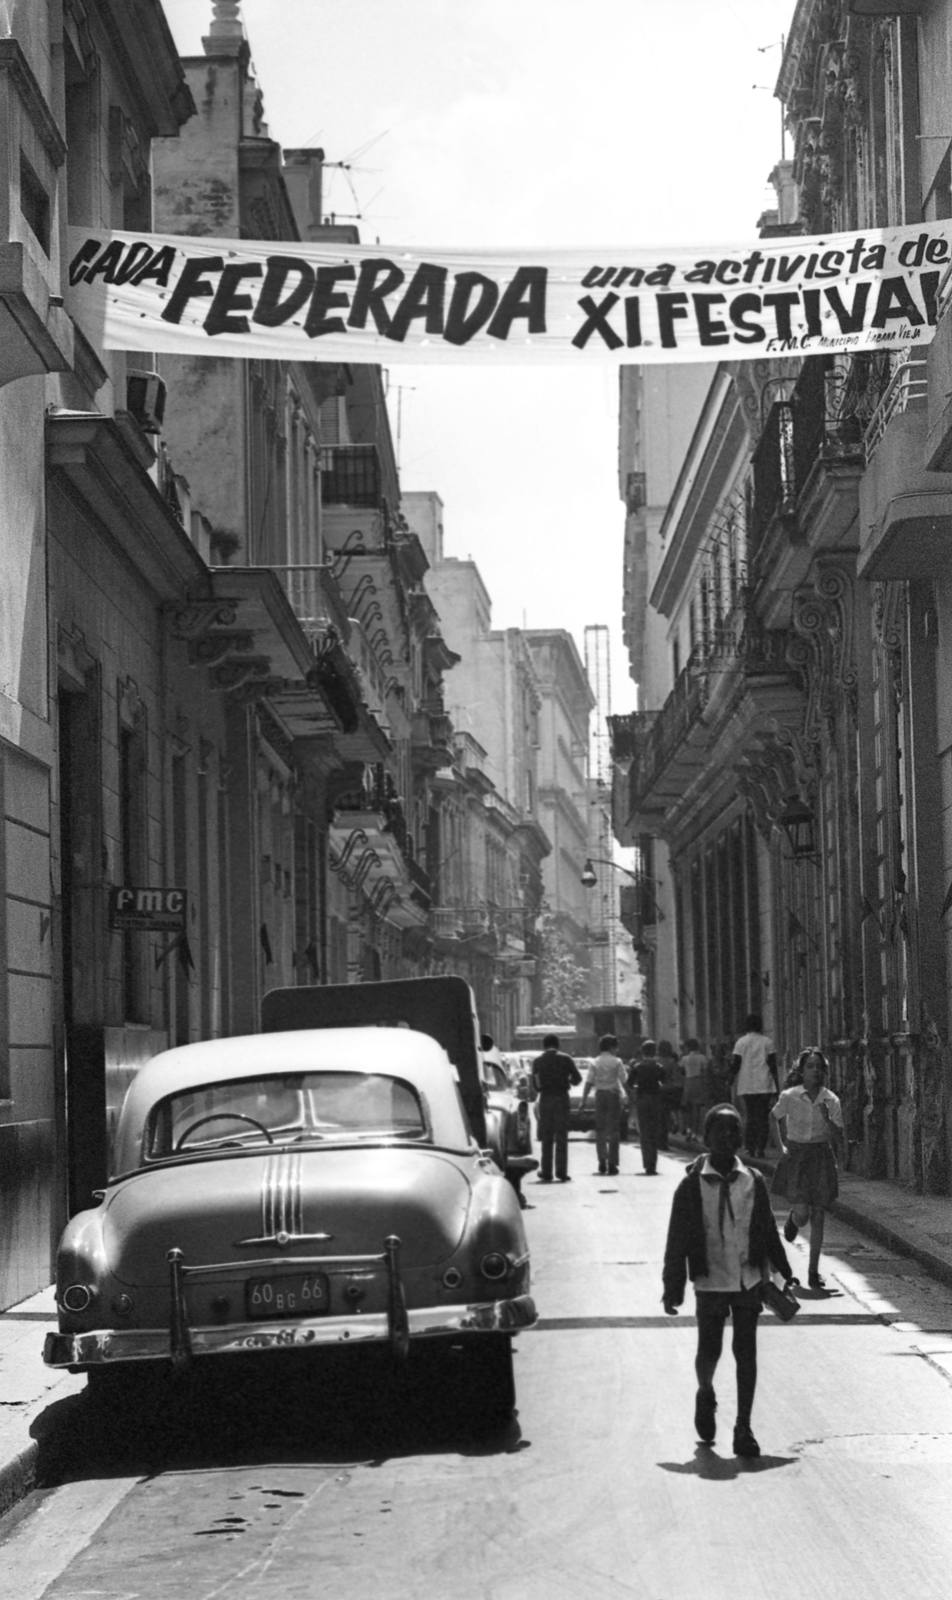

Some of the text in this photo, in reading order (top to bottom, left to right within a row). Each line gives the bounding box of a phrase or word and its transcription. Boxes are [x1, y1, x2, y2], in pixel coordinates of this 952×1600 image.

[580, 263, 676, 288] una
[684, 238, 887, 285] activista
[69, 238, 548, 346] CADA FEDERADA
[252, 1284, 273, 1304] 60
[301, 1279, 322, 1299] 66
